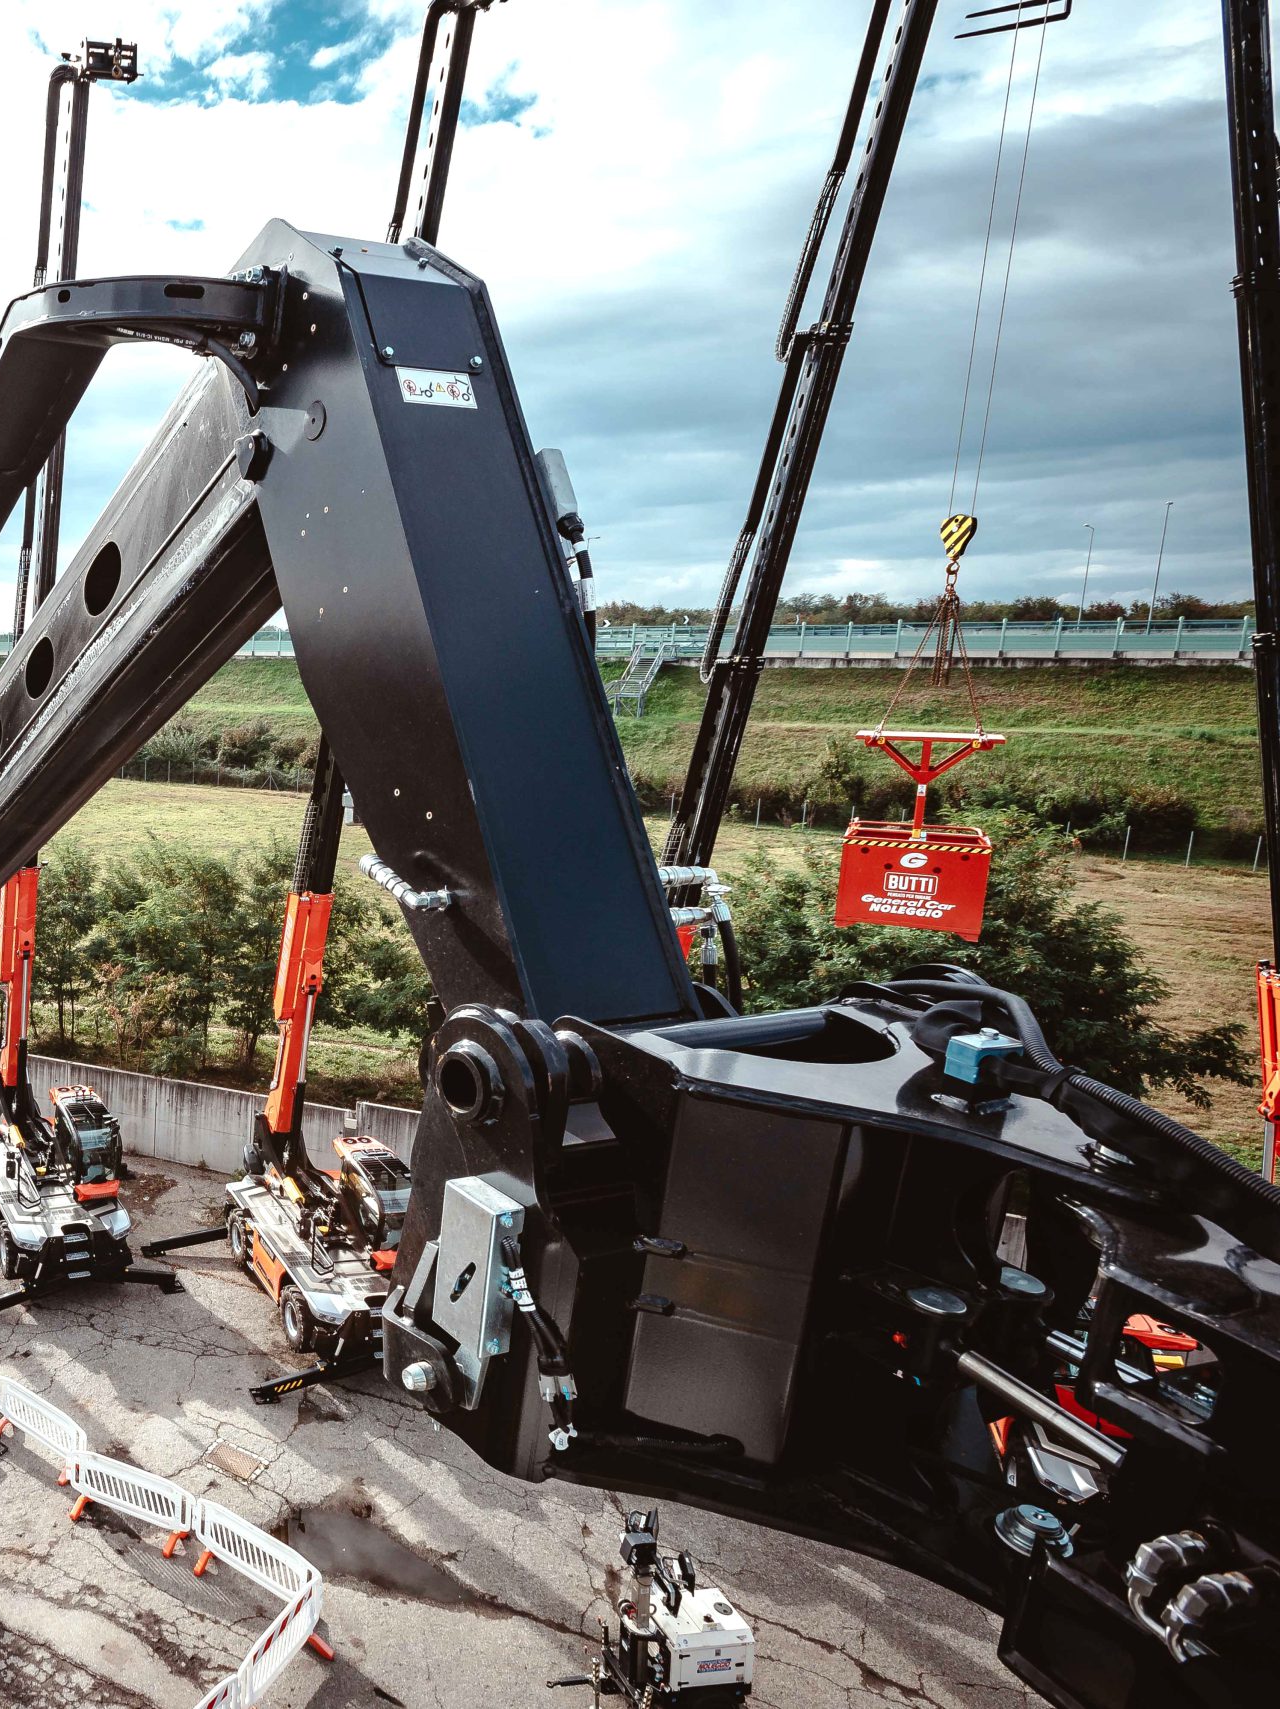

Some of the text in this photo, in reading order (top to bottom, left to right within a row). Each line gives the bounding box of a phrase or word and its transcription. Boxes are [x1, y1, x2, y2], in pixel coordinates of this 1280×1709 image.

[887, 874, 934, 893] BUTTI
[860, 894, 956, 911] General Car
[869, 902, 944, 919] NOLEGGIO
